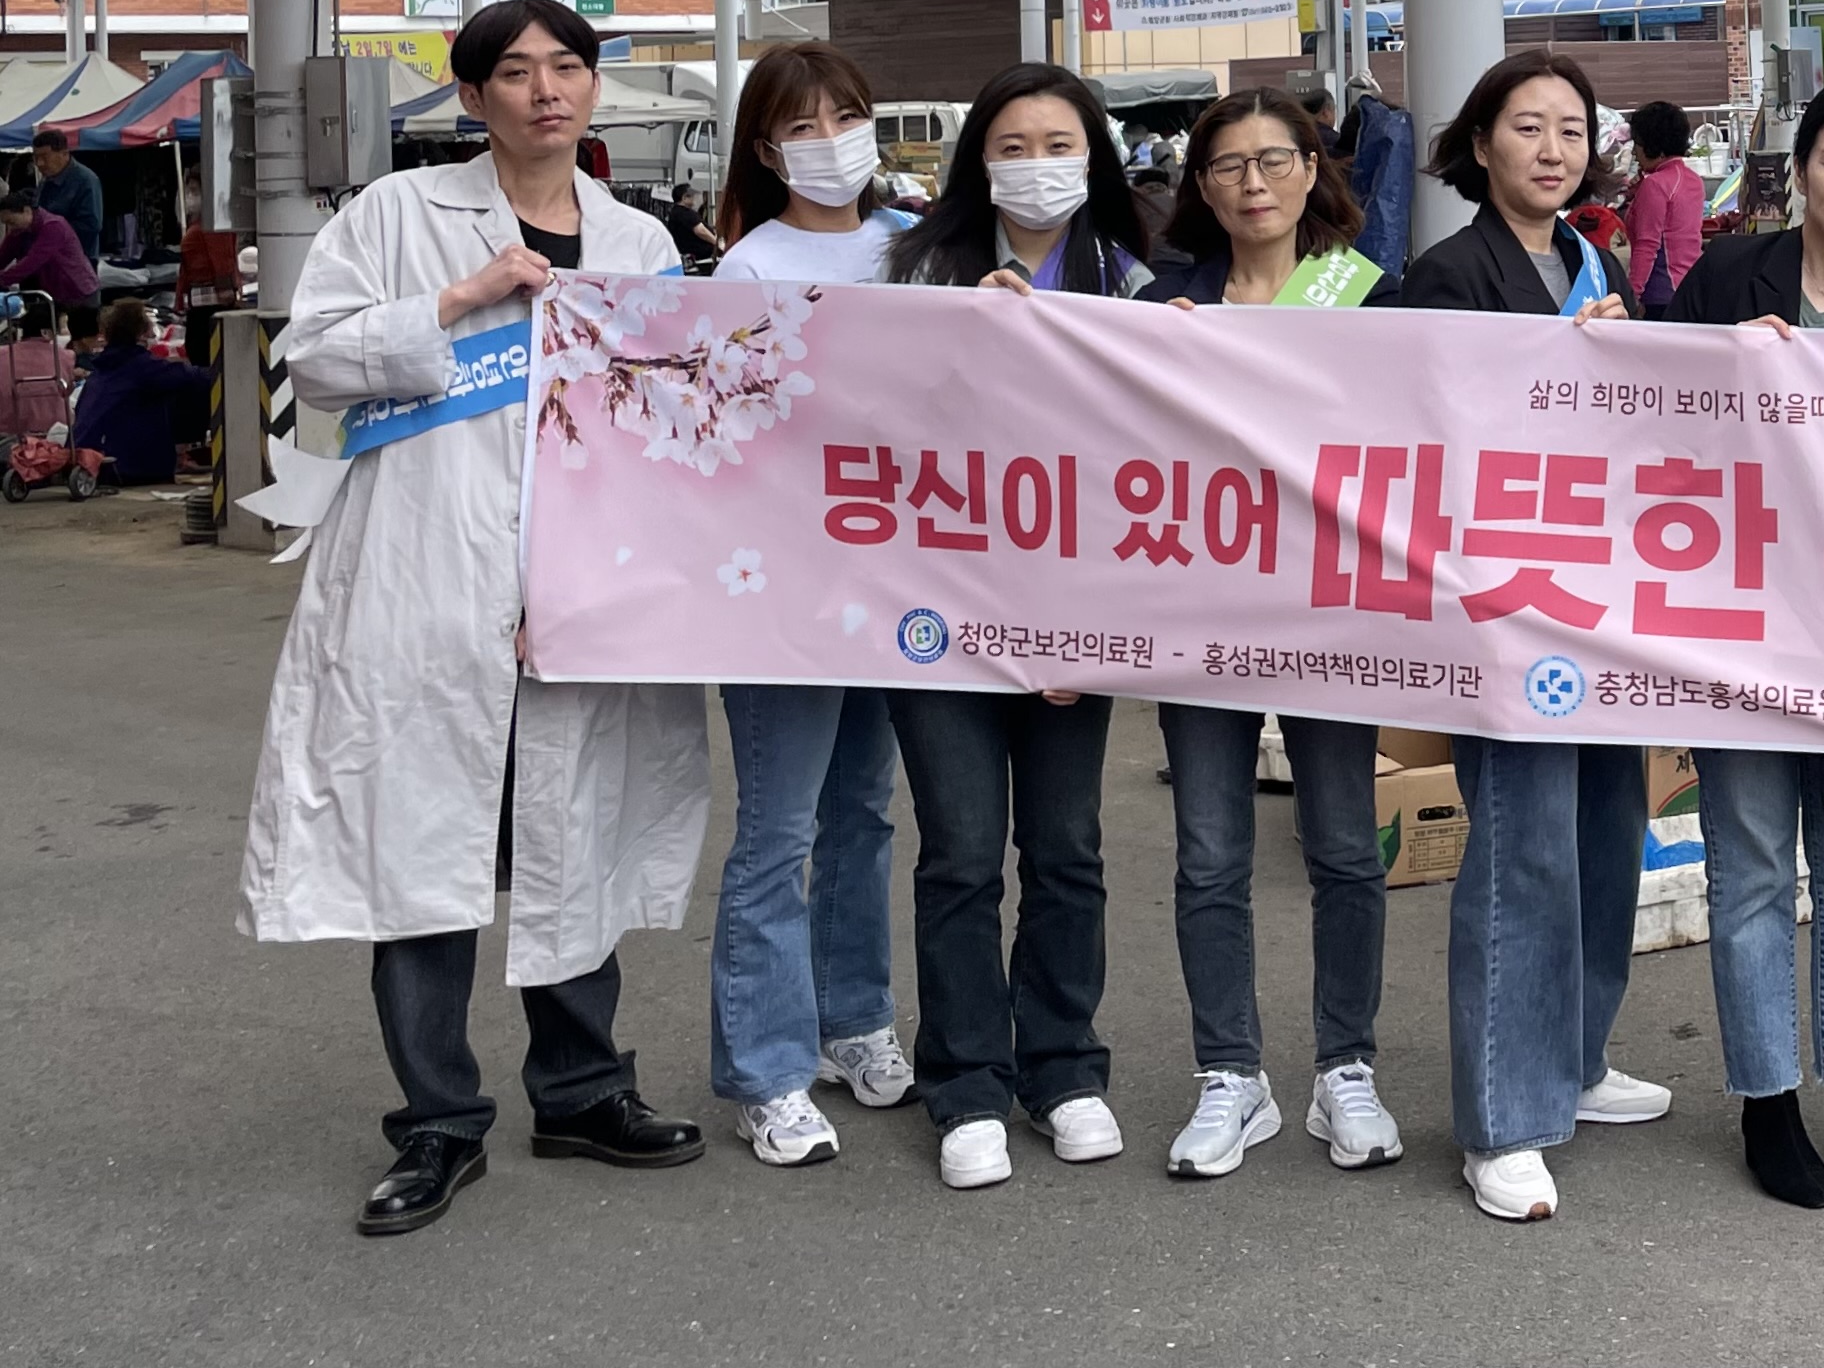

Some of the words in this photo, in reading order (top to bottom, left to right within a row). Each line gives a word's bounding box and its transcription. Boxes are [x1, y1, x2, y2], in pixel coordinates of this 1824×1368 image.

[1528, 380, 1580, 413] 삶의
[1590, 382, 1665, 417] 희망이
[1674, 385, 1746, 422] 보이지
[822, 442, 1078, 559] 당신이
[1112, 457, 1279, 575] 있어
[1311, 442, 1779, 643] 따뜻한
[957, 621, 1155, 670] 청양군보건의료원
[1201, 640, 1483, 700] 홍성권지역책임의료기관
